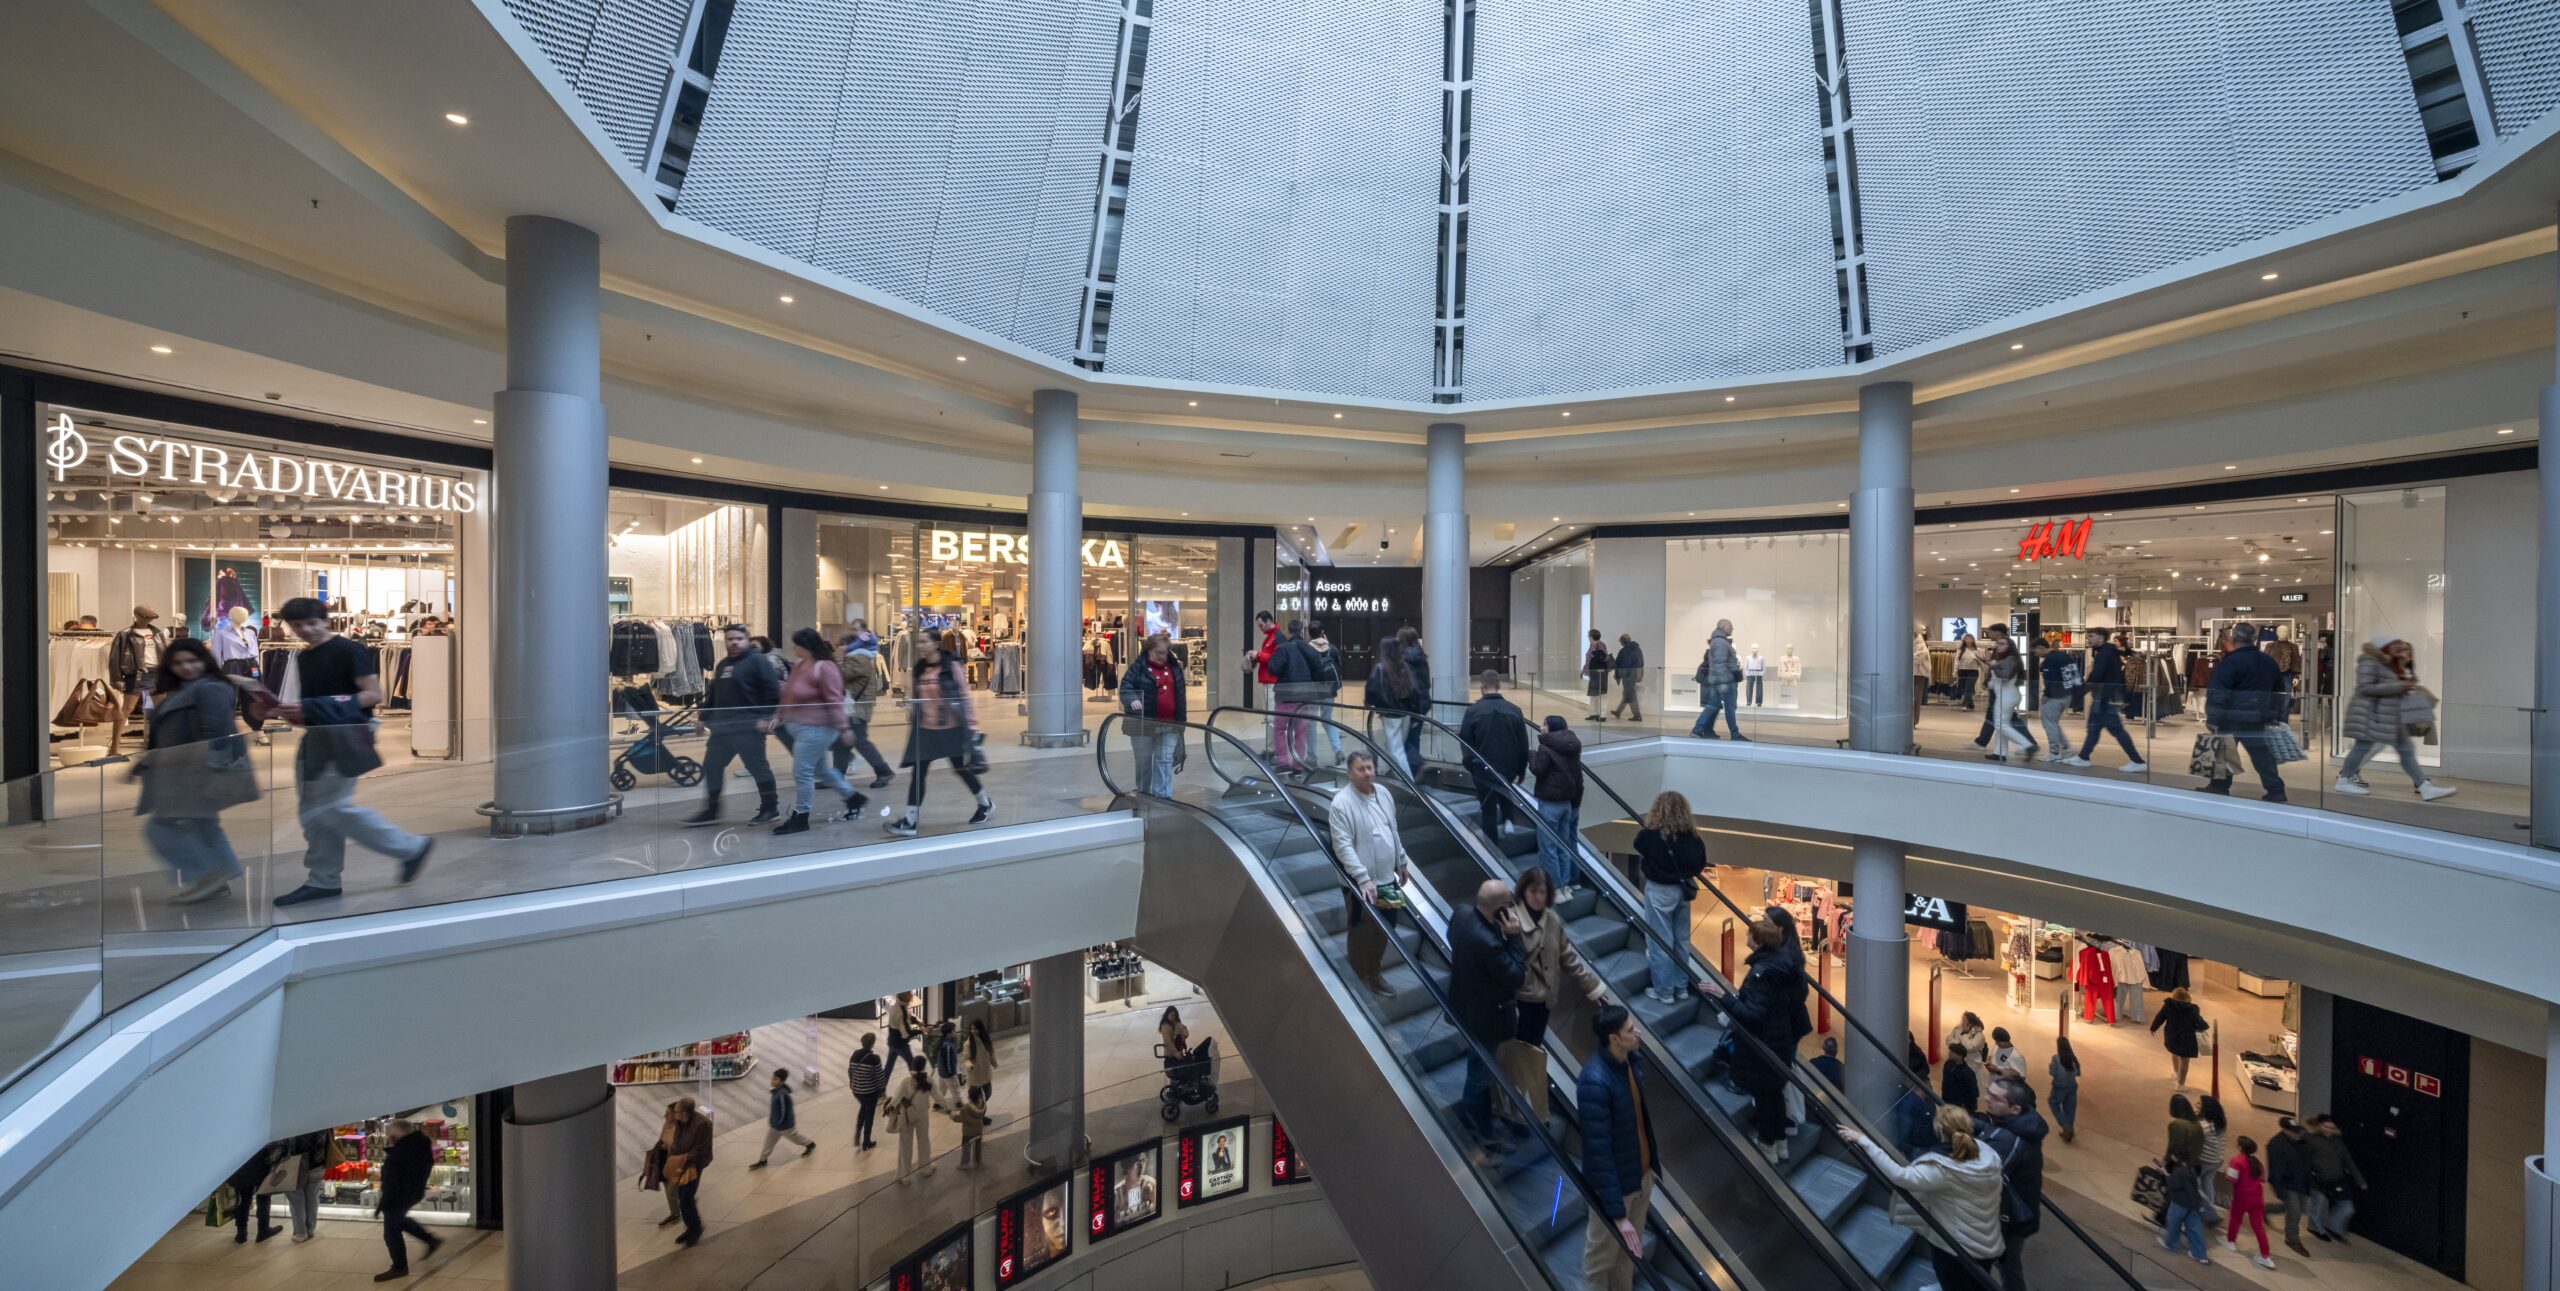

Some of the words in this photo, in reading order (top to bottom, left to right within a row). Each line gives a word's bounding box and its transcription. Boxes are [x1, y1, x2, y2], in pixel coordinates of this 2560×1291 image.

[110, 435, 476, 513] STRADIVARIUS
[931, 529, 1125, 568] BERKA
[2018, 518, 2093, 561] H&M
[1316, 580, 1352, 592] Aseos
